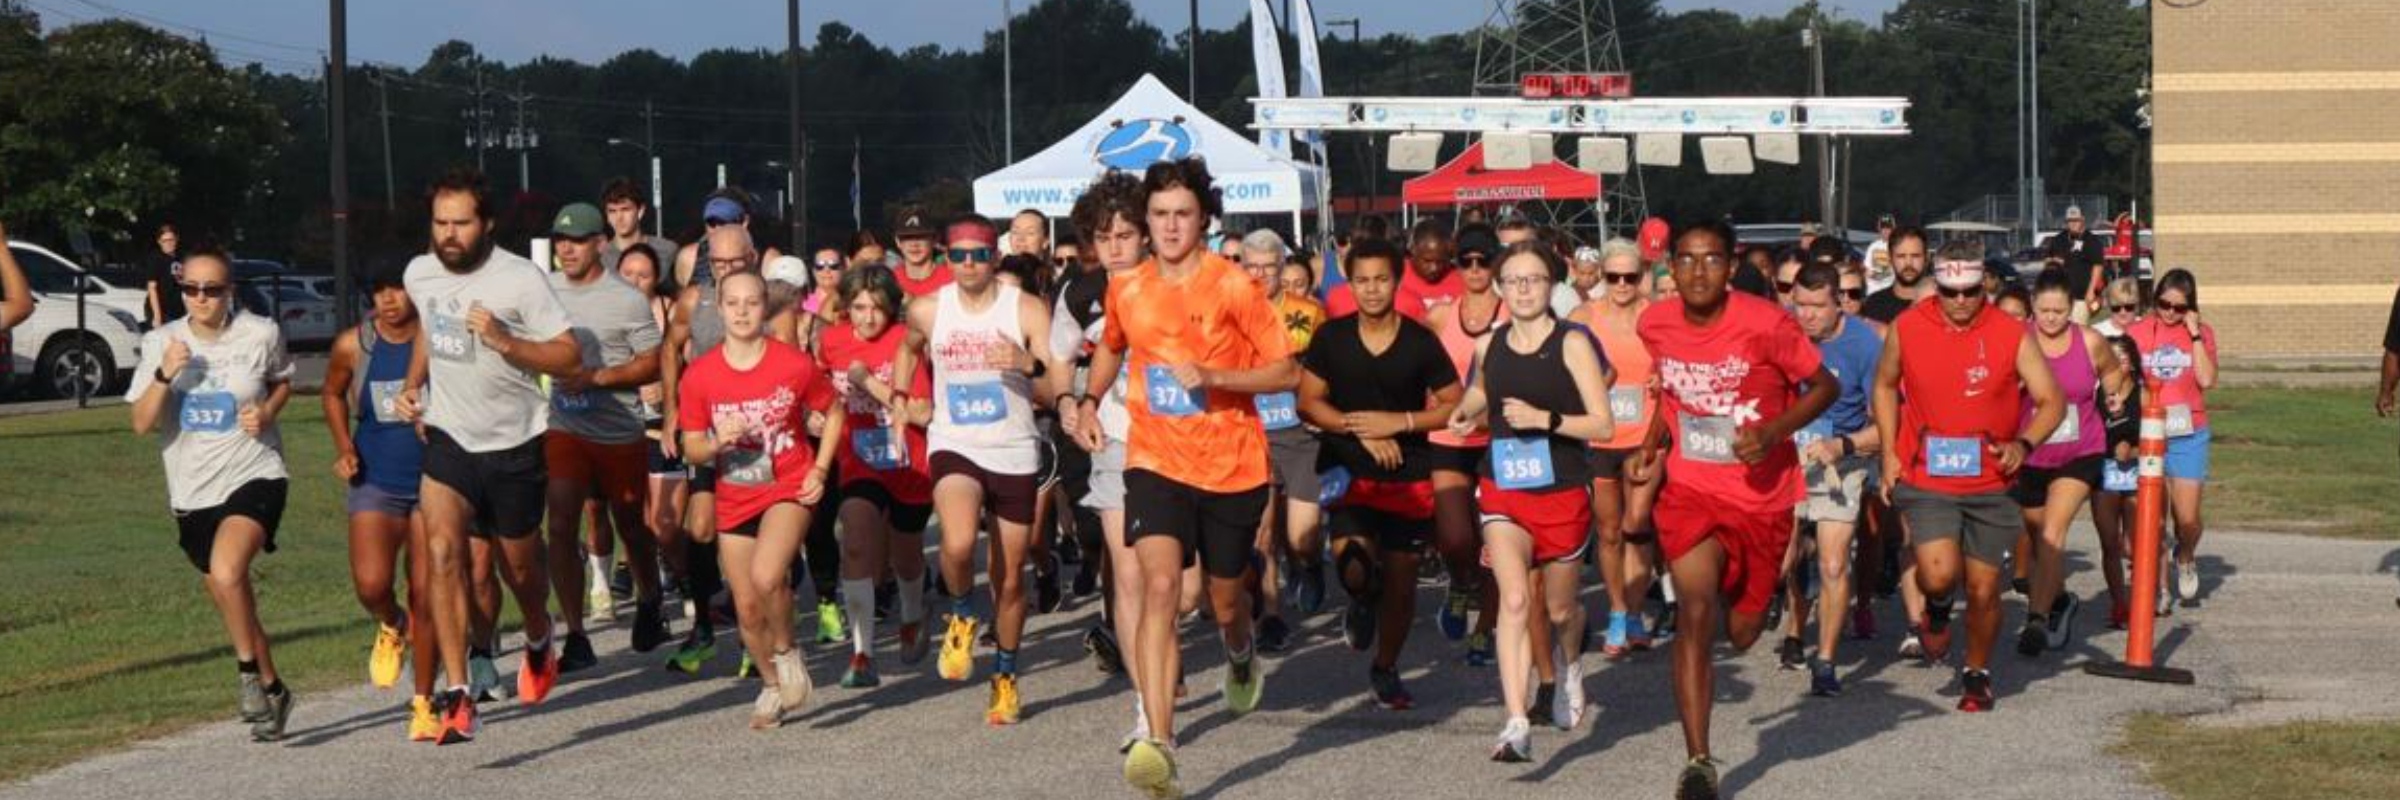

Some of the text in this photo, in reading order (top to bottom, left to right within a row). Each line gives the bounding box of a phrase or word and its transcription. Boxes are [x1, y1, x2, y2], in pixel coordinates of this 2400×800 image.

[1946, 262, 1961, 277] N
[432, 334, 466, 355] 985
[186, 409, 225, 424] 337
[956, 398, 996, 418] 346
[1689, 432, 1728, 456] 998
[1502, 458, 1544, 479] 358
[1936, 453, 1972, 469] 347
